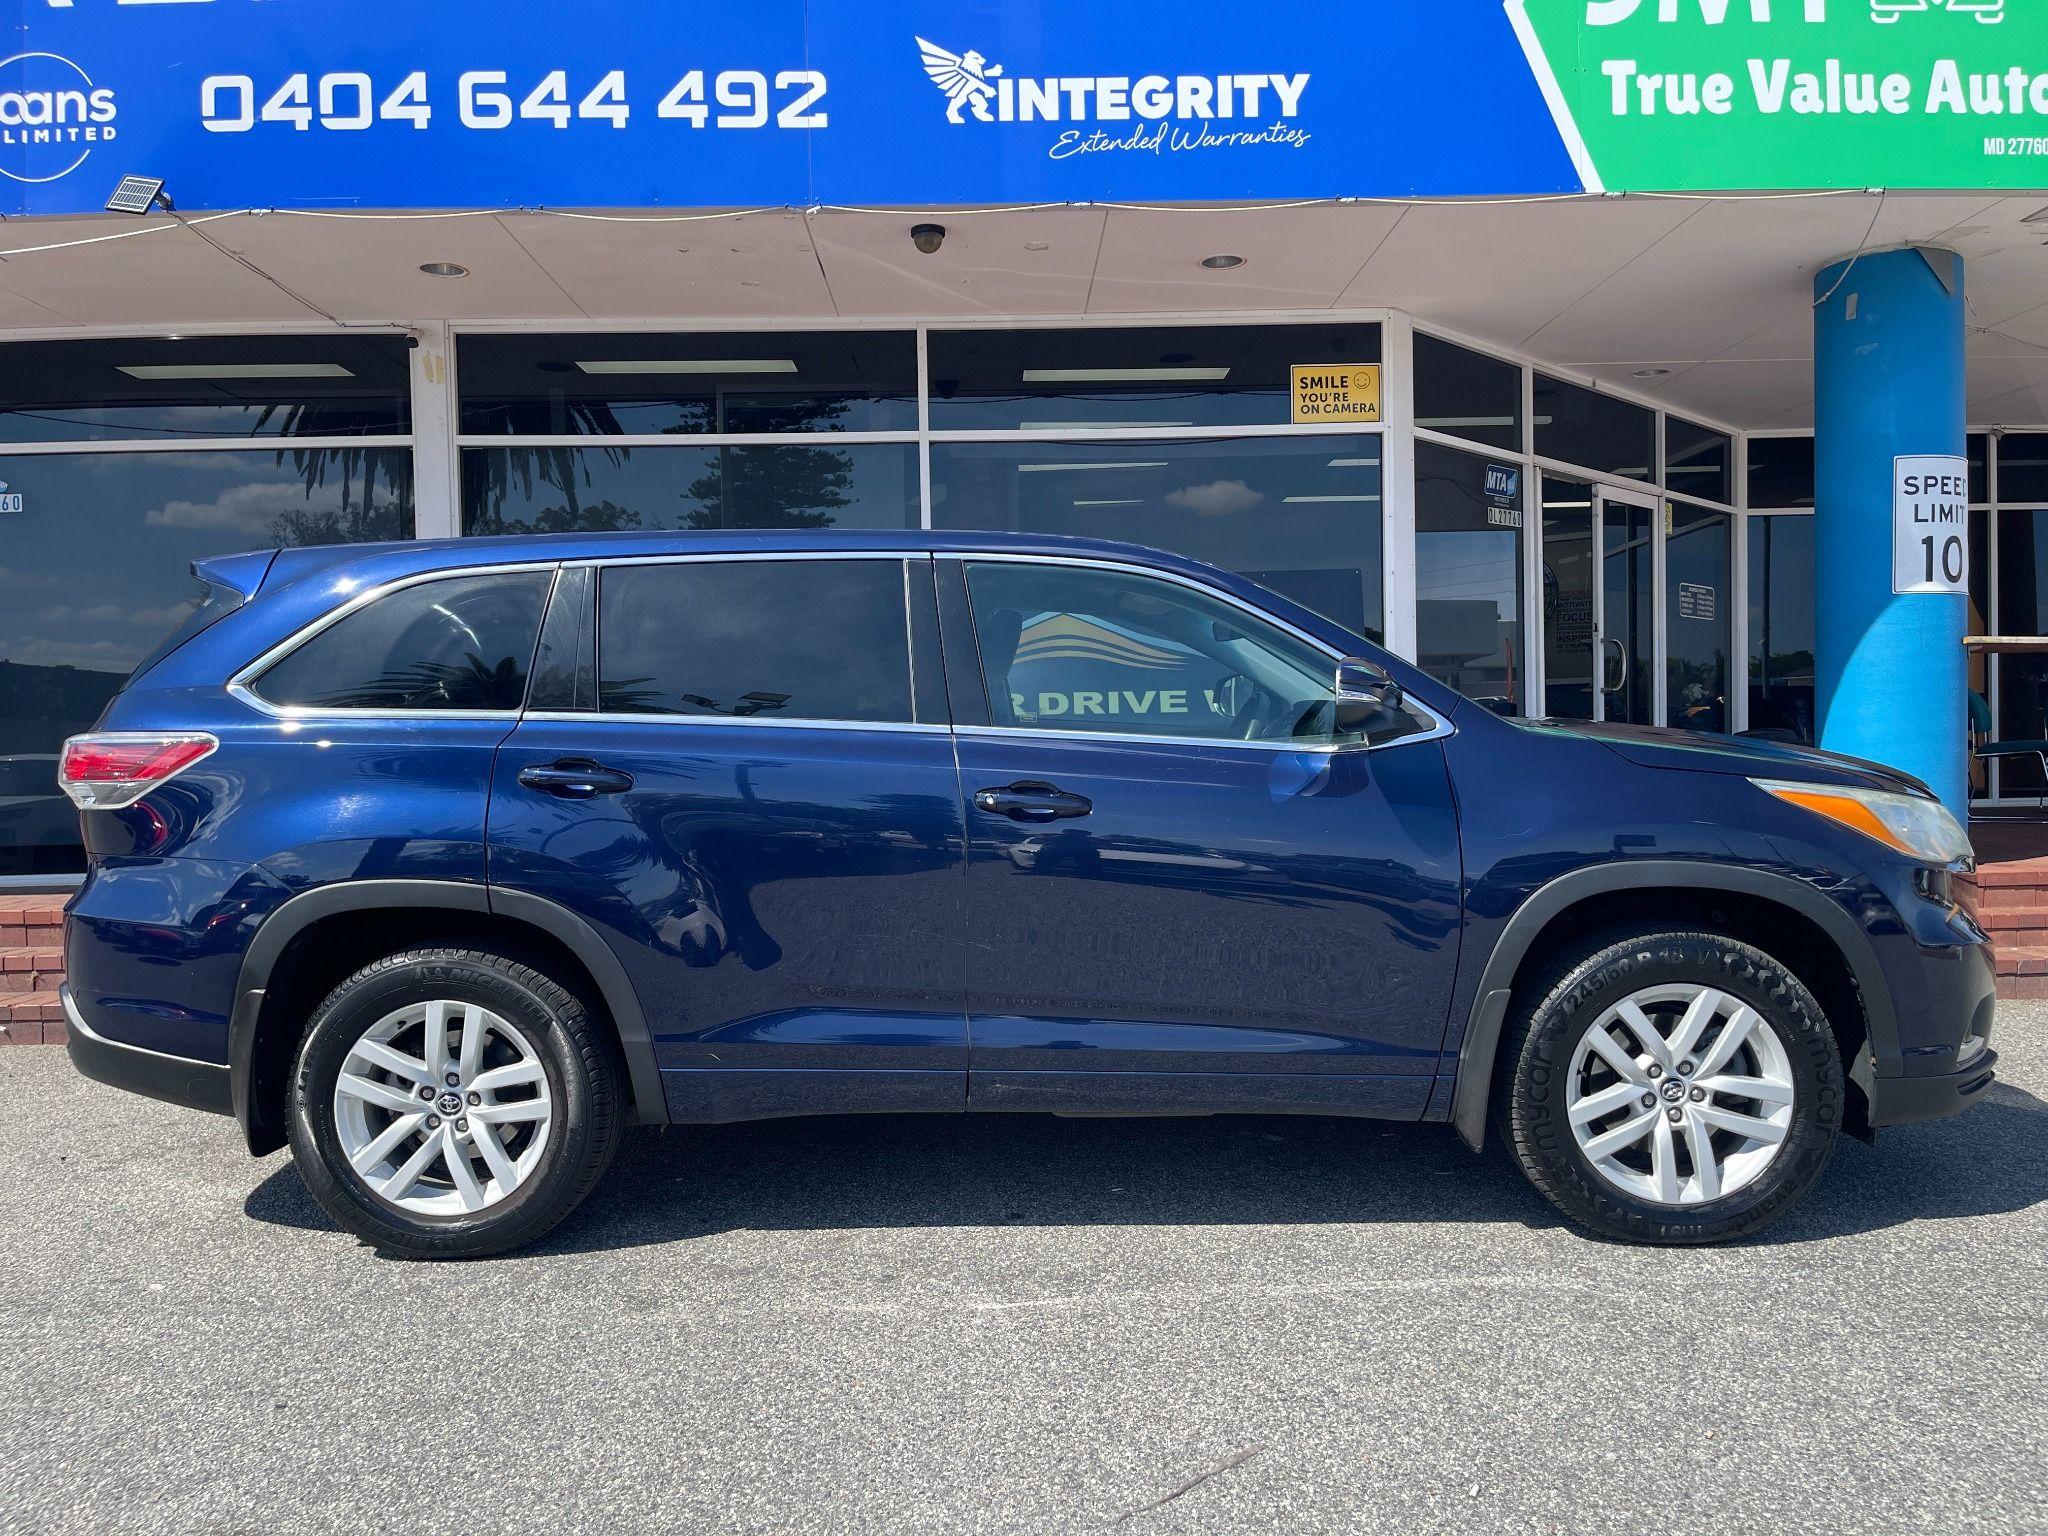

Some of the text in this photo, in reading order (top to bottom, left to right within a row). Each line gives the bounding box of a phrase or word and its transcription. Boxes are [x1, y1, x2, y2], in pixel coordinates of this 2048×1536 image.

[998, 73, 1311, 121] INTEGRITY
[1602, 60, 1733, 115] True
[1747, 59, 1910, 114] Value
[202, 71, 827, 131] 0404 644 492
[3, 126, 117, 144] LIMITED
[1049, 121, 1312, 159] Extended Warranties
[1983, 137, 2005, 155] MD
[1299, 375, 1349, 389] SMILE
[1300, 392, 1349, 403] YOU'RE
[1301, 402, 1376, 419] ON CAMERA
[1487, 470, 1507, 492] MTA
[1913, 503, 1965, 524] LIMIT
[1921, 535, 1963, 584] 10
[1039, 690, 1189, 716] DRIVE
